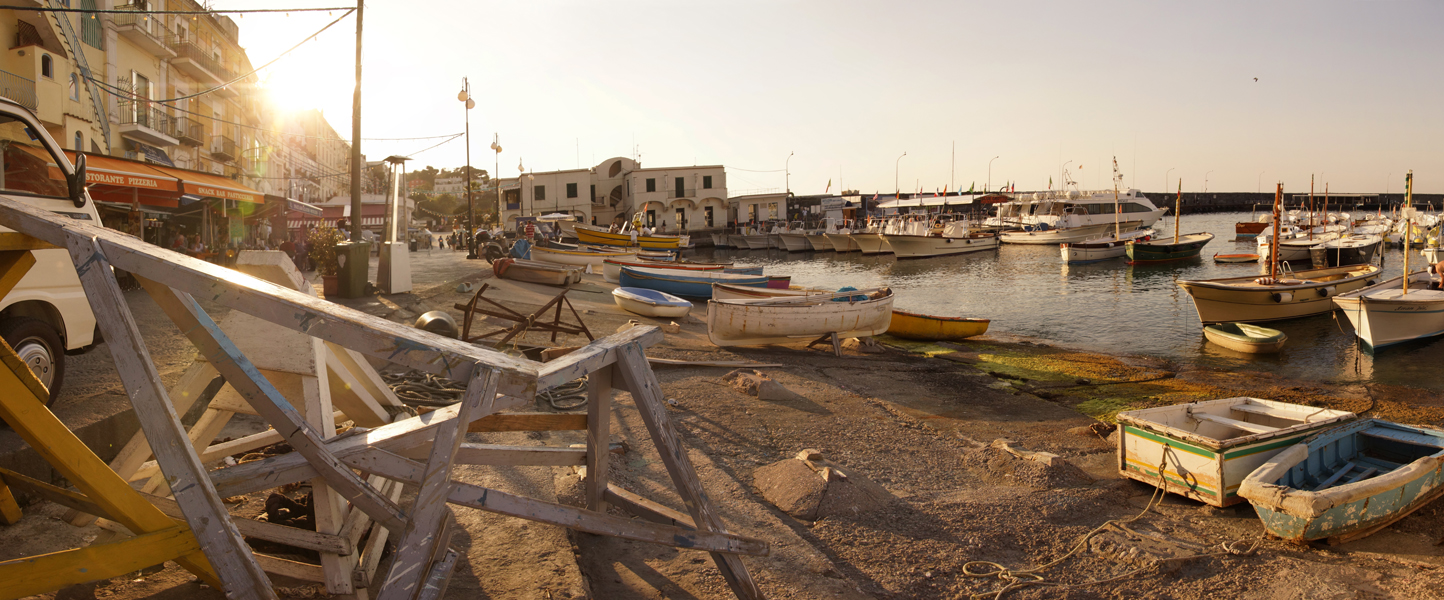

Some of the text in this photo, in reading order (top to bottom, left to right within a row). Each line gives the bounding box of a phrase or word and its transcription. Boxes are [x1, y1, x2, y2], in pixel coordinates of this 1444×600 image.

[86, 173, 158, 187] STORANTE PIZZERIA
[198, 187, 215, 196] SNACK
[227, 192, 254, 200] PASTICCERIA
